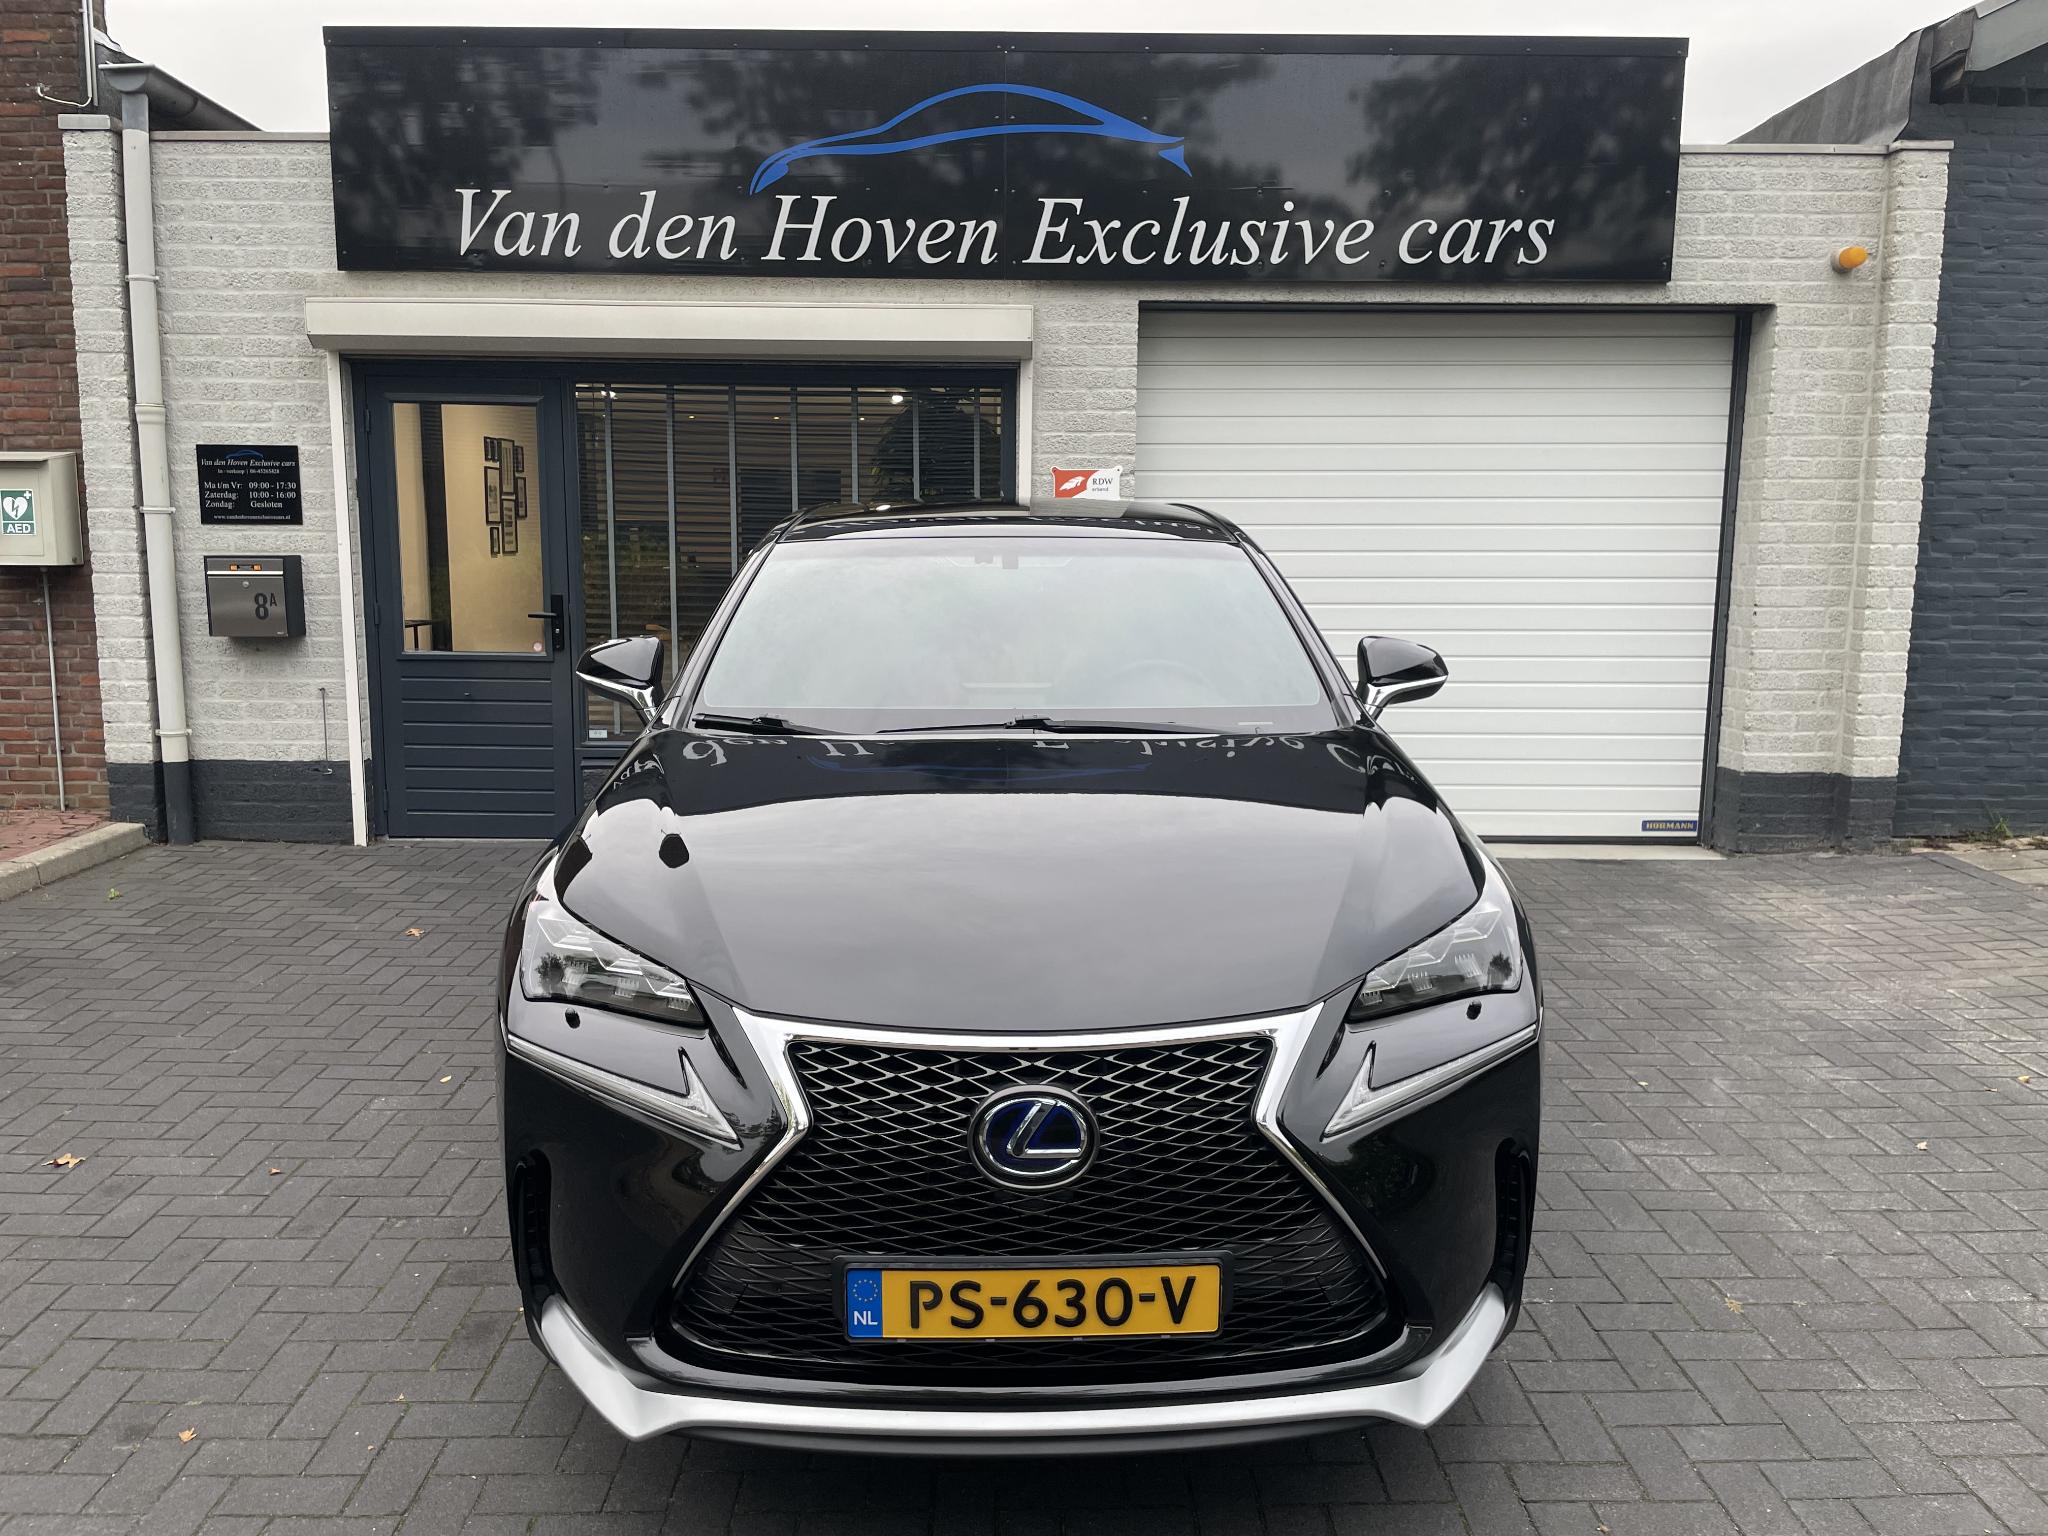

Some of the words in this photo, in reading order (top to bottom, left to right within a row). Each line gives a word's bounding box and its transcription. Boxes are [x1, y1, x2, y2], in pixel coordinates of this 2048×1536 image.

[455, 188, 582, 258] Van
[608, 189, 738, 261] den
[760, 193, 999, 265] Hoven
[1021, 195, 1375, 266] Exclusive
[1398, 218, 1556, 265] cars
[214, 458, 226, 466] den
[227, 458, 248, 466] Hoven
[250, 459, 281, 467] Exclusive
[204, 482, 216, 490] Ma
[248, 482, 270, 490] 09:00
[276, 482, 297, 490] 17:30
[1092, 477, 1114, 486] RDW
[204, 491, 239, 501] Zaterdag:
[249, 491, 270, 499] 10:00
[276, 491, 297, 499] 16:00
[205, 500, 235, 510] Zondag:
[250, 500, 283, 509] Gesloten
[6, 523, 31, 534] AED
[909, 1275, 1197, 1329] PS-630-V
[853, 1310, 878, 1326] NL
